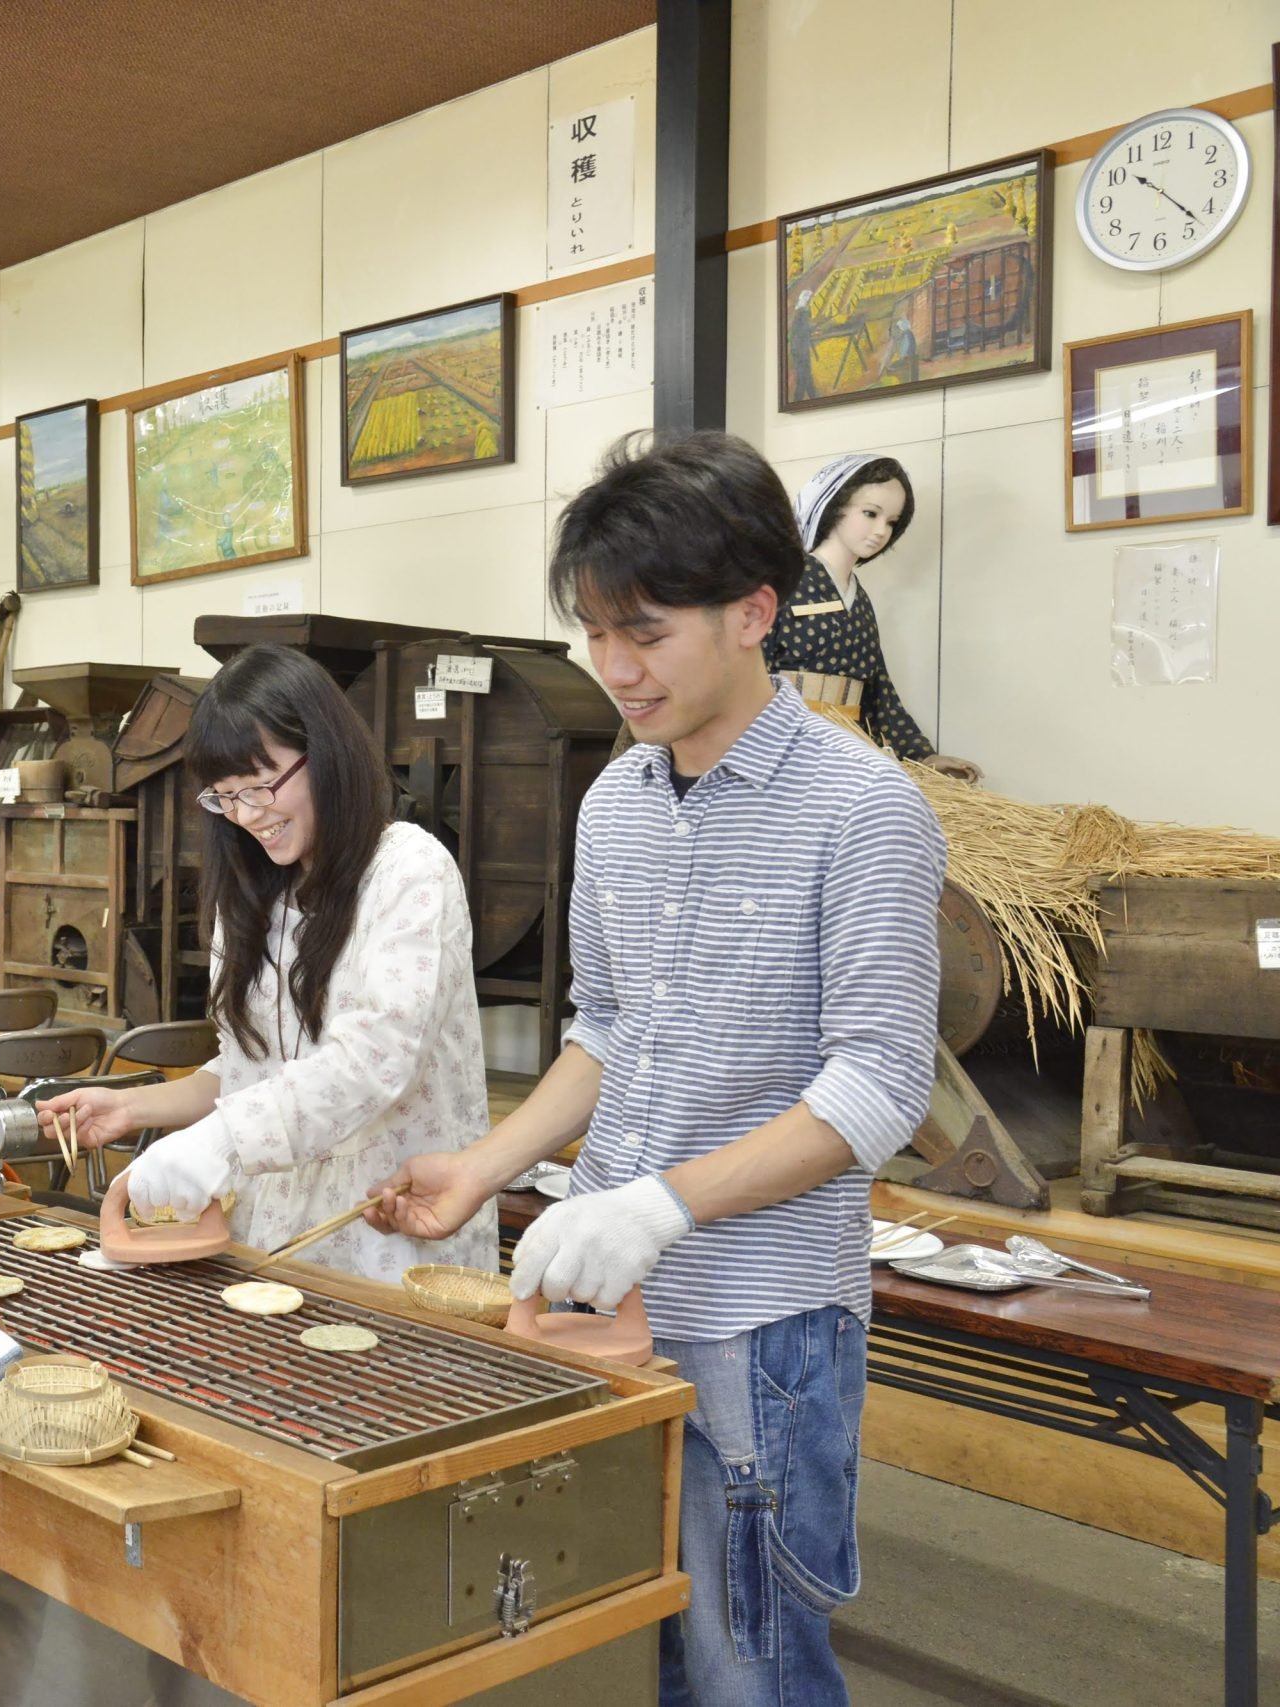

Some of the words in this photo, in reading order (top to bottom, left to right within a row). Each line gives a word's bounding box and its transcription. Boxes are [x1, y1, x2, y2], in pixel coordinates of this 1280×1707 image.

[570, 115, 597, 184] 収穫
[1151, 130, 1173, 152] 12
[1187, 131, 1195, 149] 1
[1127, 144, 1143, 164] 11
[1204, 144, 1218, 165] 2
[1107, 166, 1127, 187] 10
[1212, 169, 1228, 189] 3
[1099, 195, 1113, 215] 9
[1201, 196, 1215, 215] 4
[570, 196, 585, 255] とりいれ
[1109, 218, 1122, 237] 8
[1182, 221, 1195, 240] 5
[1128, 232, 1141, 251] 7
[1153, 232, 1167, 251] 6
